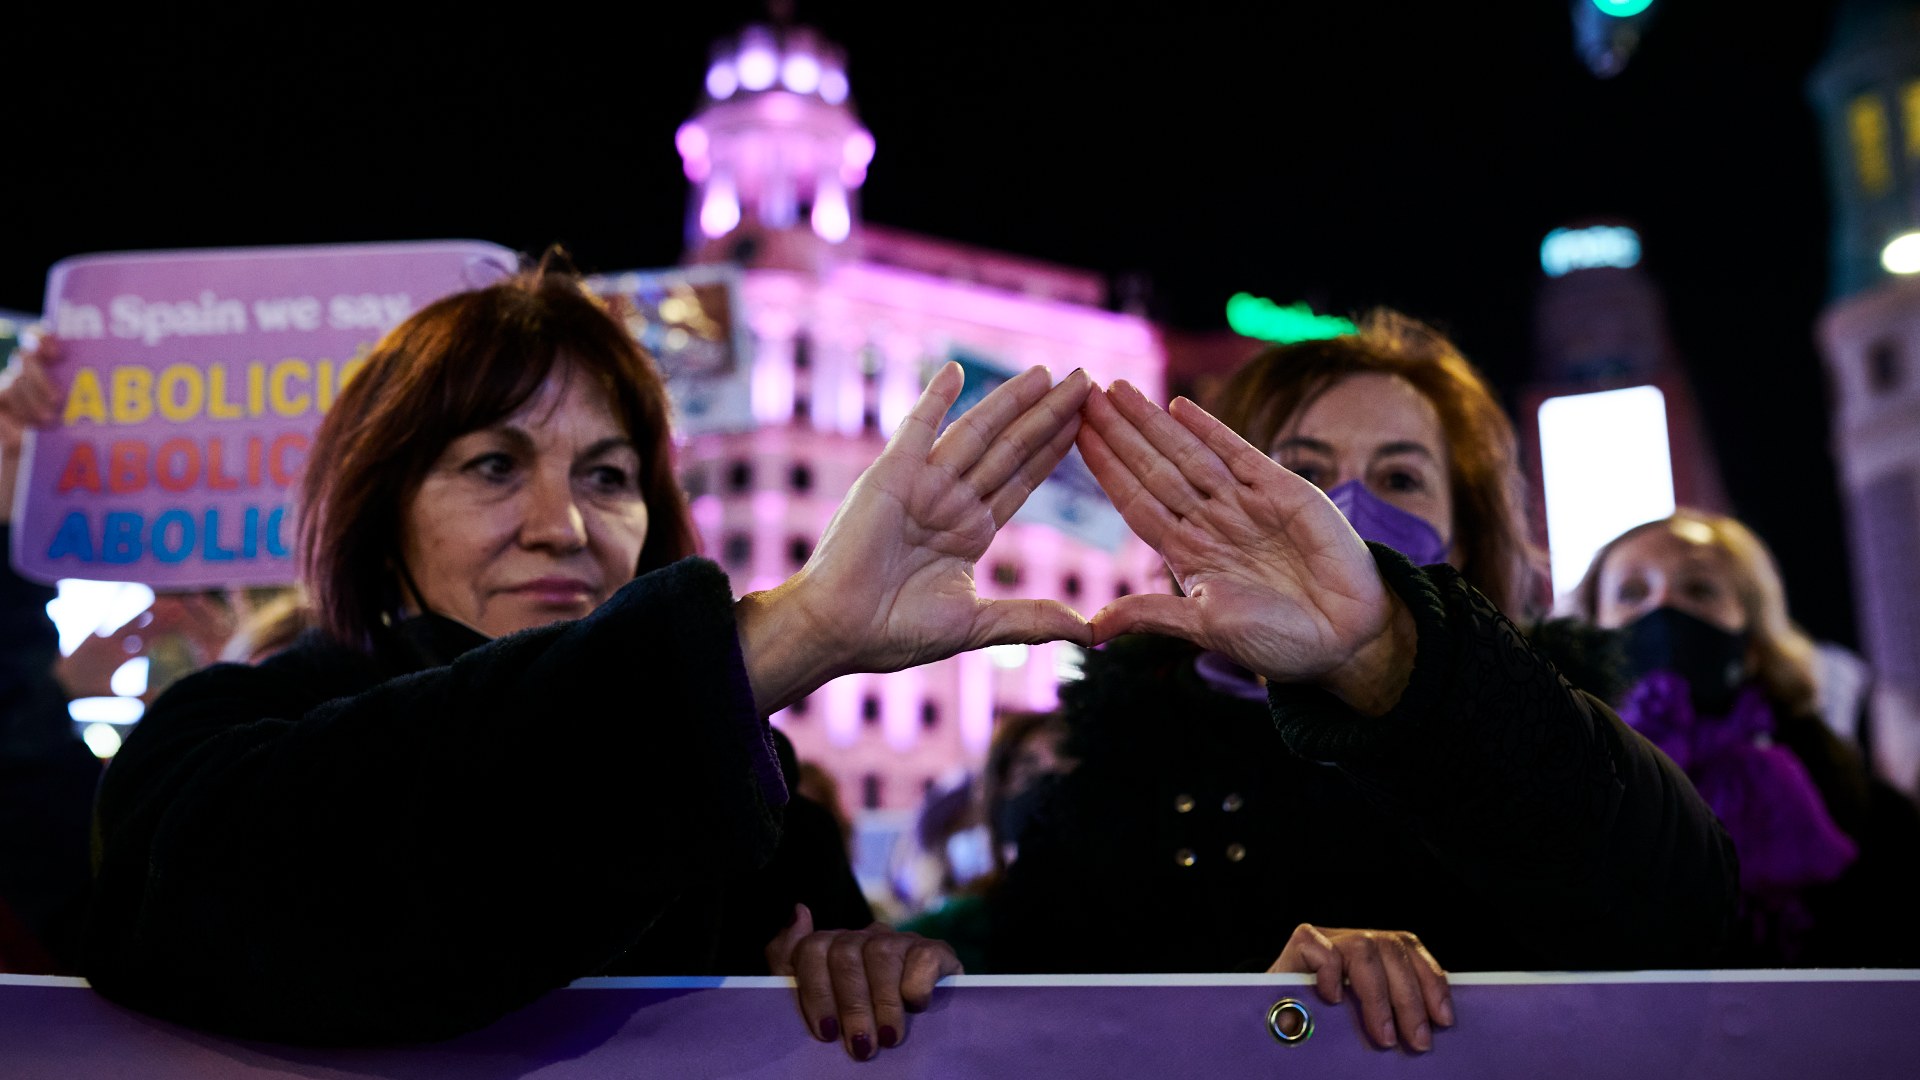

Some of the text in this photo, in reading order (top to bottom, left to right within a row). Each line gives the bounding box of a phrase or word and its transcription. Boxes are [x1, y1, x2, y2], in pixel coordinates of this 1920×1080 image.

[58, 290, 411, 345] In Spain we say
[58, 432, 307, 492] ABOLIC
